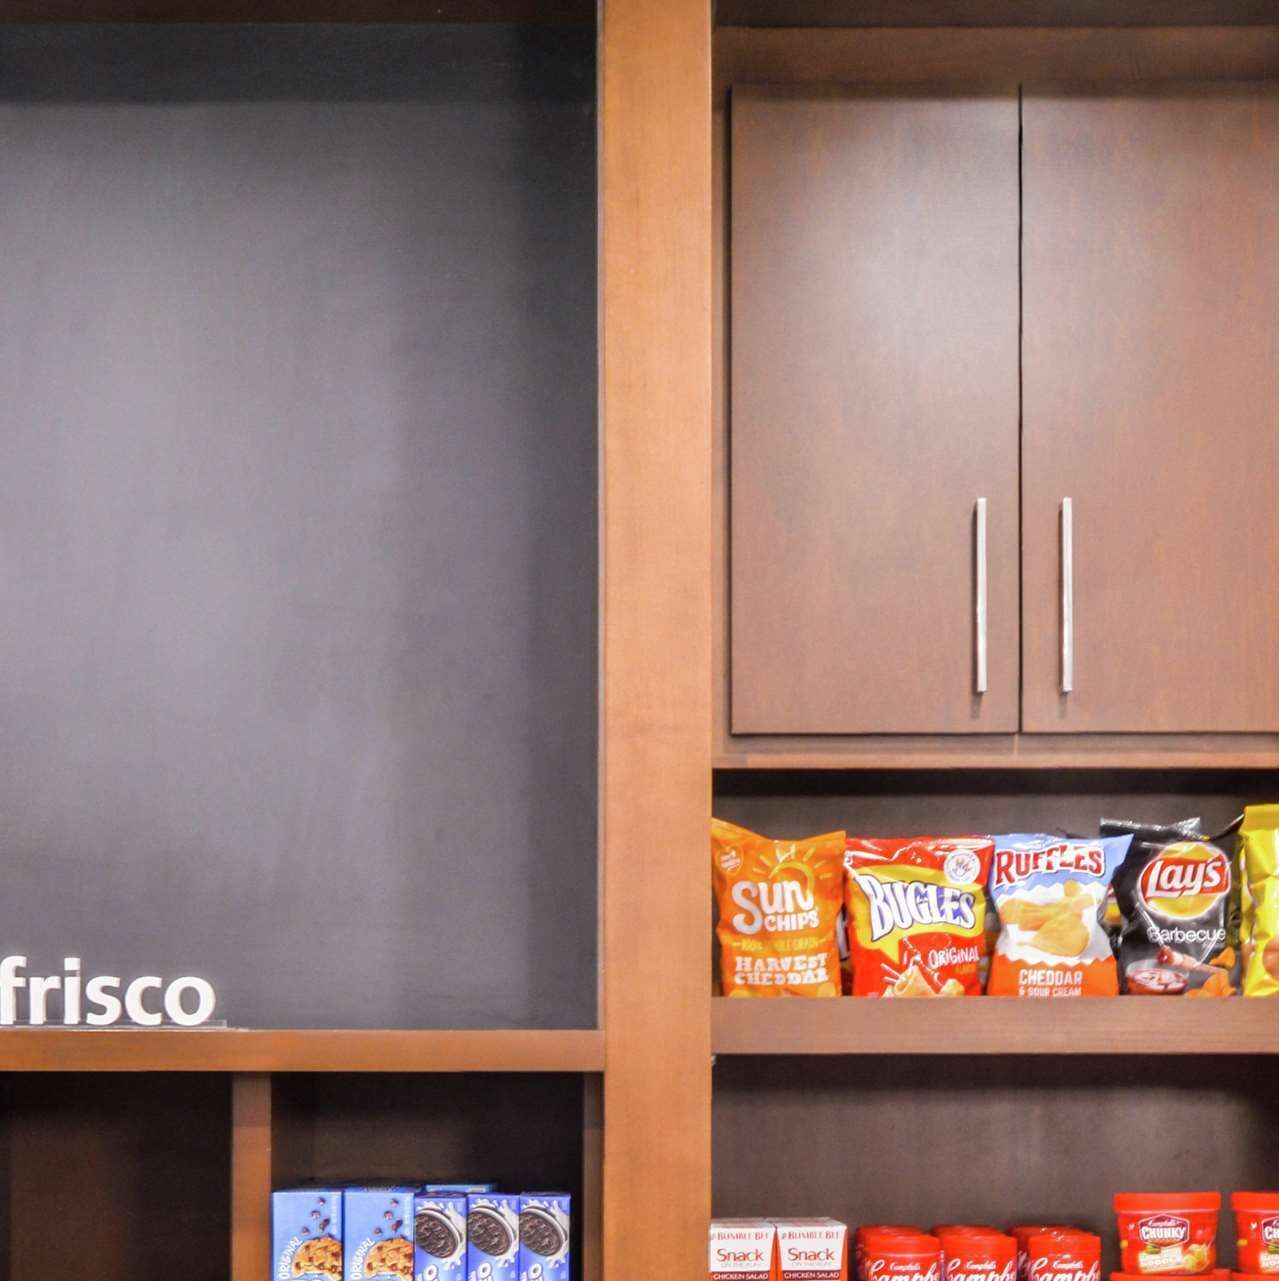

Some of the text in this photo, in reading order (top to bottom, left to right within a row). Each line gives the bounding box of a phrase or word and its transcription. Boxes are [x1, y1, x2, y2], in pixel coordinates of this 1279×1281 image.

[995, 843, 1104, 885] RUFFLES
[1146, 859, 1223, 898] Lay's
[732, 880, 814, 934] Sun
[853, 873, 976, 942] BUGLES
[764, 910, 819, 932] CHIPS
[1147, 926, 1226, 943] Barbecue
[735, 952, 827, 972] HARVEST
[735, 968, 829, 985] CHEDDAR
[1019, 969, 1083, 985] CHEDDAR
[1141, 1226, 1187, 1240] CHUNKY
[279, 1236, 303, 1280] ORIGINAL
[351, 1237, 375, 1281] ORIGINAL
[717, 1248, 764, 1262] Snack
[788, 1247, 835, 1261] Snack
[713, 1272, 769, 1280] CHICKEN SALAD
[784, 1271, 839, 1280] CHICKEN SALAD
